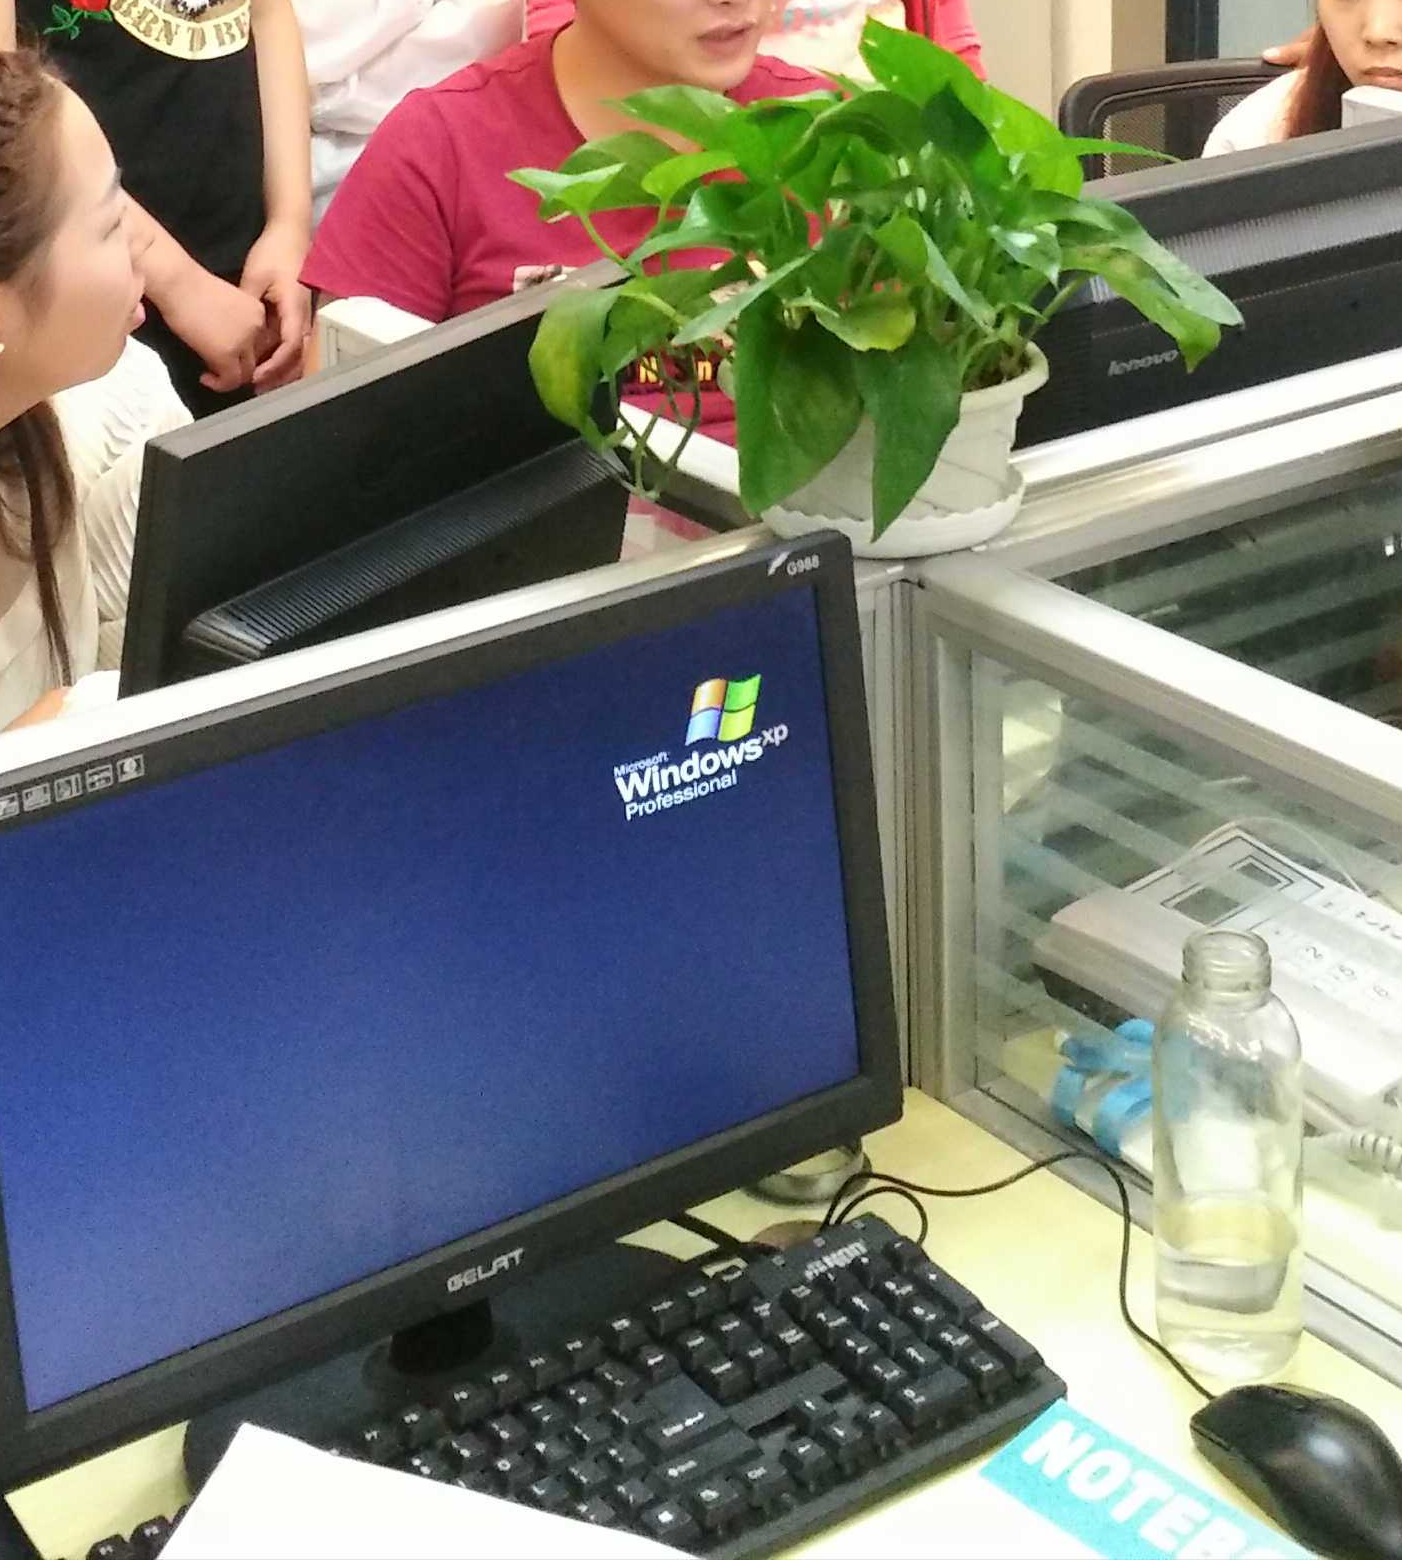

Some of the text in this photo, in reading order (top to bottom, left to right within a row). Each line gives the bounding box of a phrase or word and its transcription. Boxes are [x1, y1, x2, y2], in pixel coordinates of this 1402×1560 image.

[613, 751, 668, 777] Microsoft
[615, 737, 763, 803] Windows
[625, 768, 738, 821] Professional
[1022, 1418, 1279, 1559] NOTEB
